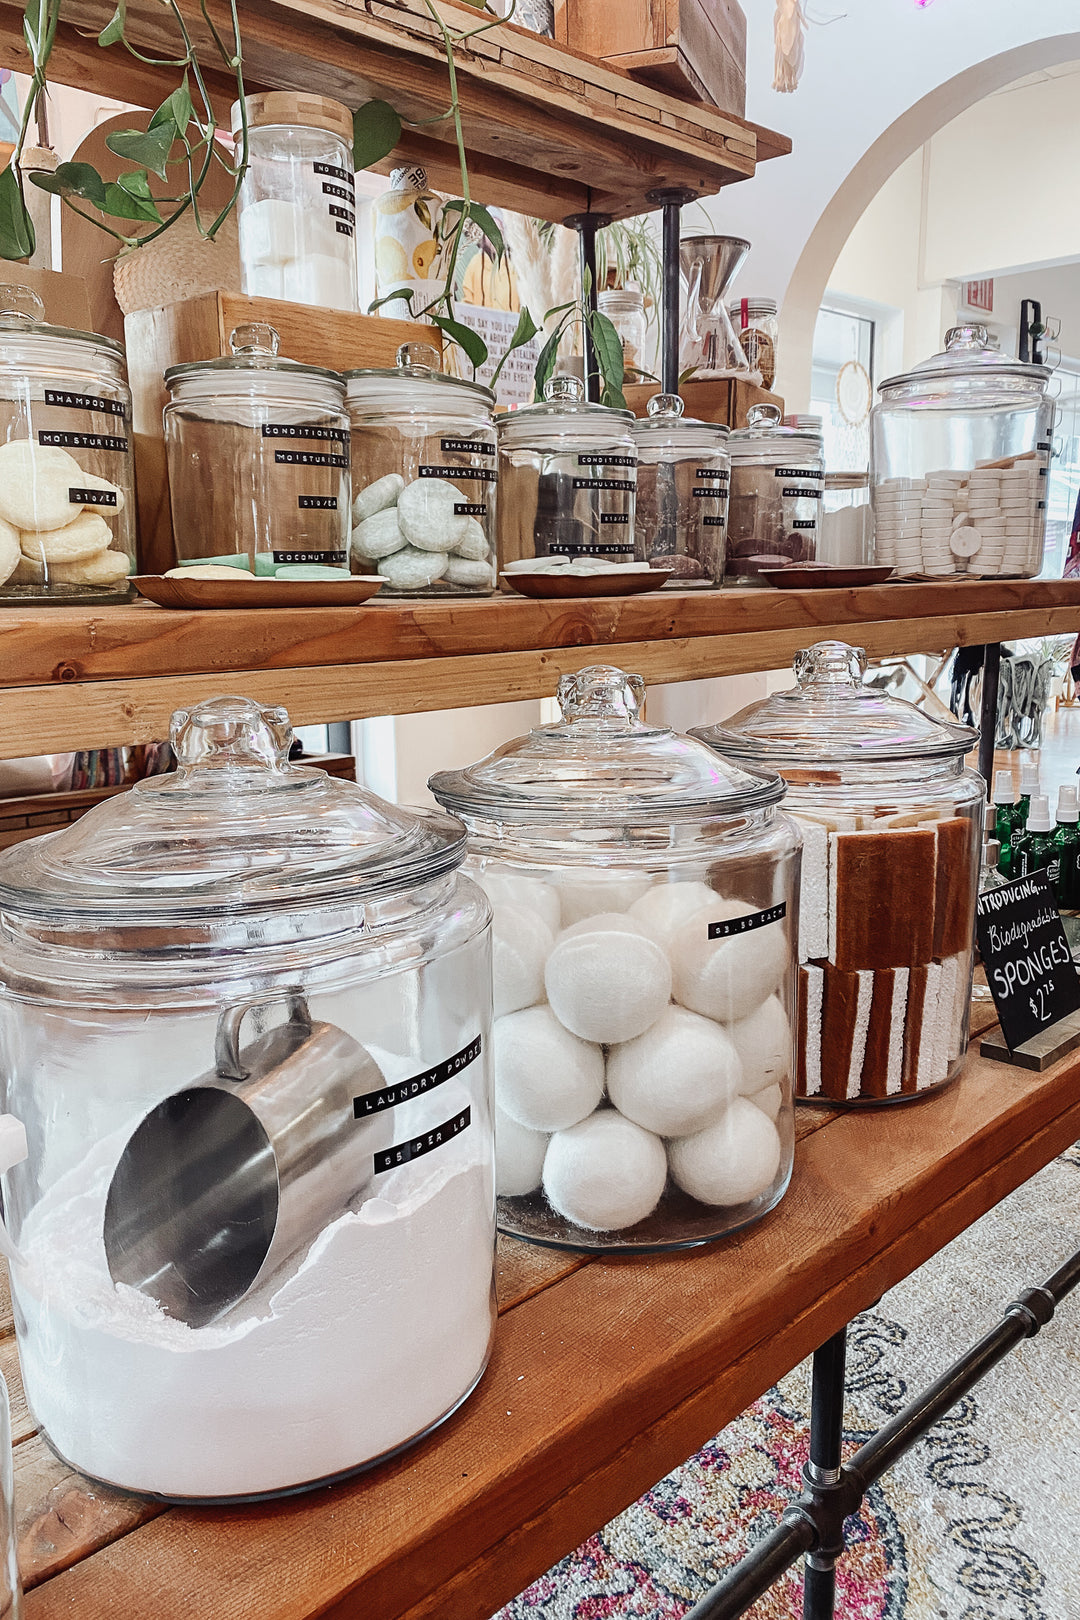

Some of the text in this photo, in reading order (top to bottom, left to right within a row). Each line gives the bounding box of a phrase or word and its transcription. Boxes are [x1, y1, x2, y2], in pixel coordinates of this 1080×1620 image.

[48, 394, 105, 408] SHAMPOO
[265, 427, 339, 439] CONDITIONER
[445, 442, 482, 451] SHAMPOO
[421, 468, 486, 478] STIMULATING
[576, 481, 630, 489] STIMULATING
[278, 553, 325, 561] COCONUT
[976, 879, 1048, 916] NTRODUCING...
[760, 907, 783, 923] EACH
[987, 907, 1060, 954] Biodegradable
[993, 935, 1071, 999] SPONGES
[365, 1073, 437, 1110] LAUNDRY
[416, 1132, 442, 1152] PER
[453, 1116, 465, 1132] LB
